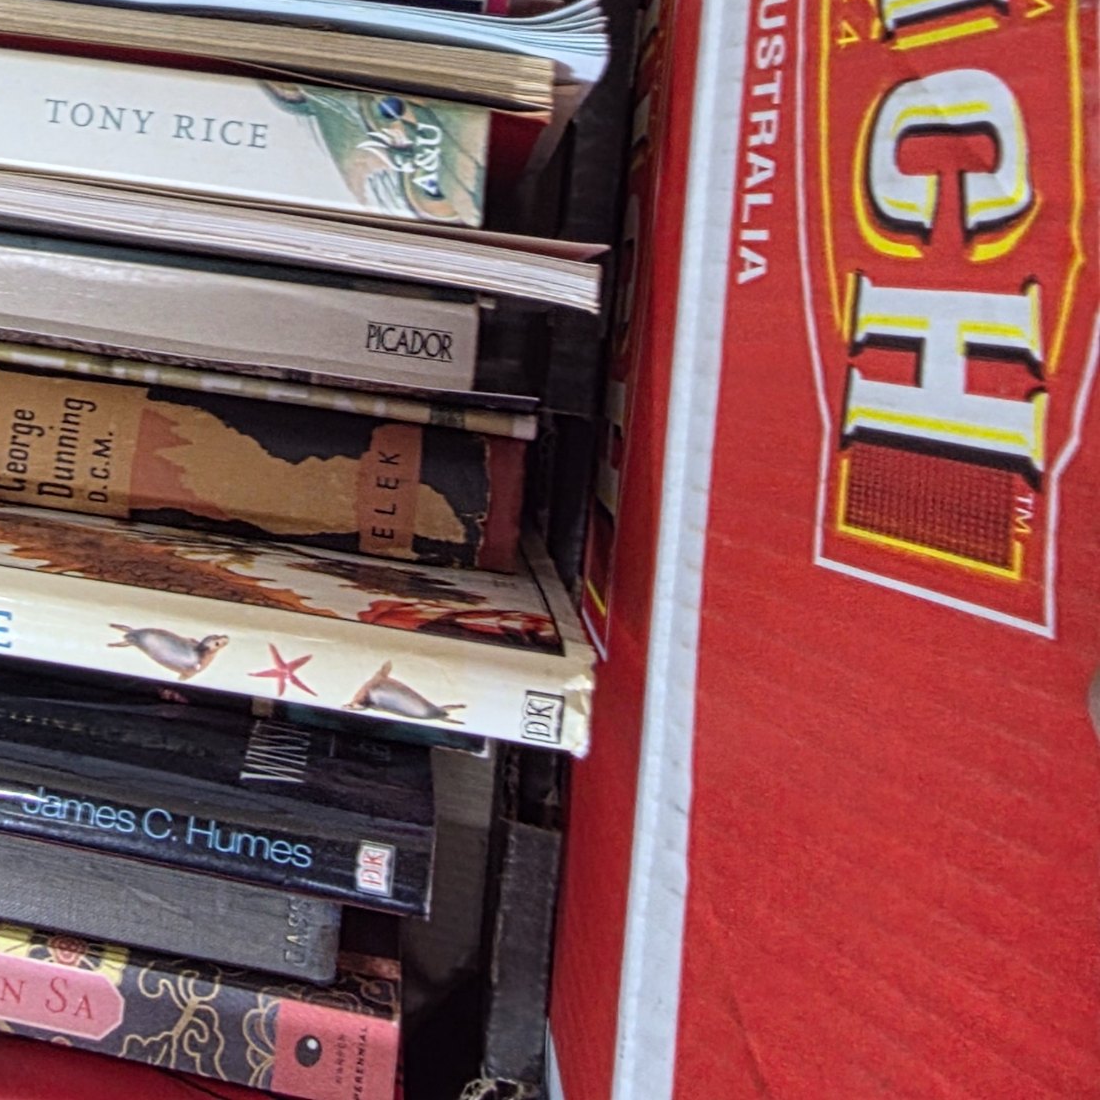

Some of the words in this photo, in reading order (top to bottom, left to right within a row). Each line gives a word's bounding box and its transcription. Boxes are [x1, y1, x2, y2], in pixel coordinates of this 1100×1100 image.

[45, 98, 155, 134] TONY
[171, 113, 268, 150] RICE
[365, 322, 455, 360] PICADOR
[37, 397, 98, 500] Dunning
[371, 450, 401, 541] ELEK
[522, 693, 561, 742] DK
[22, 786, 136, 833] James
[142, 807, 179, 843] C.
[186, 814, 313, 869] Humes
[358, 847, 390, 890] DK
